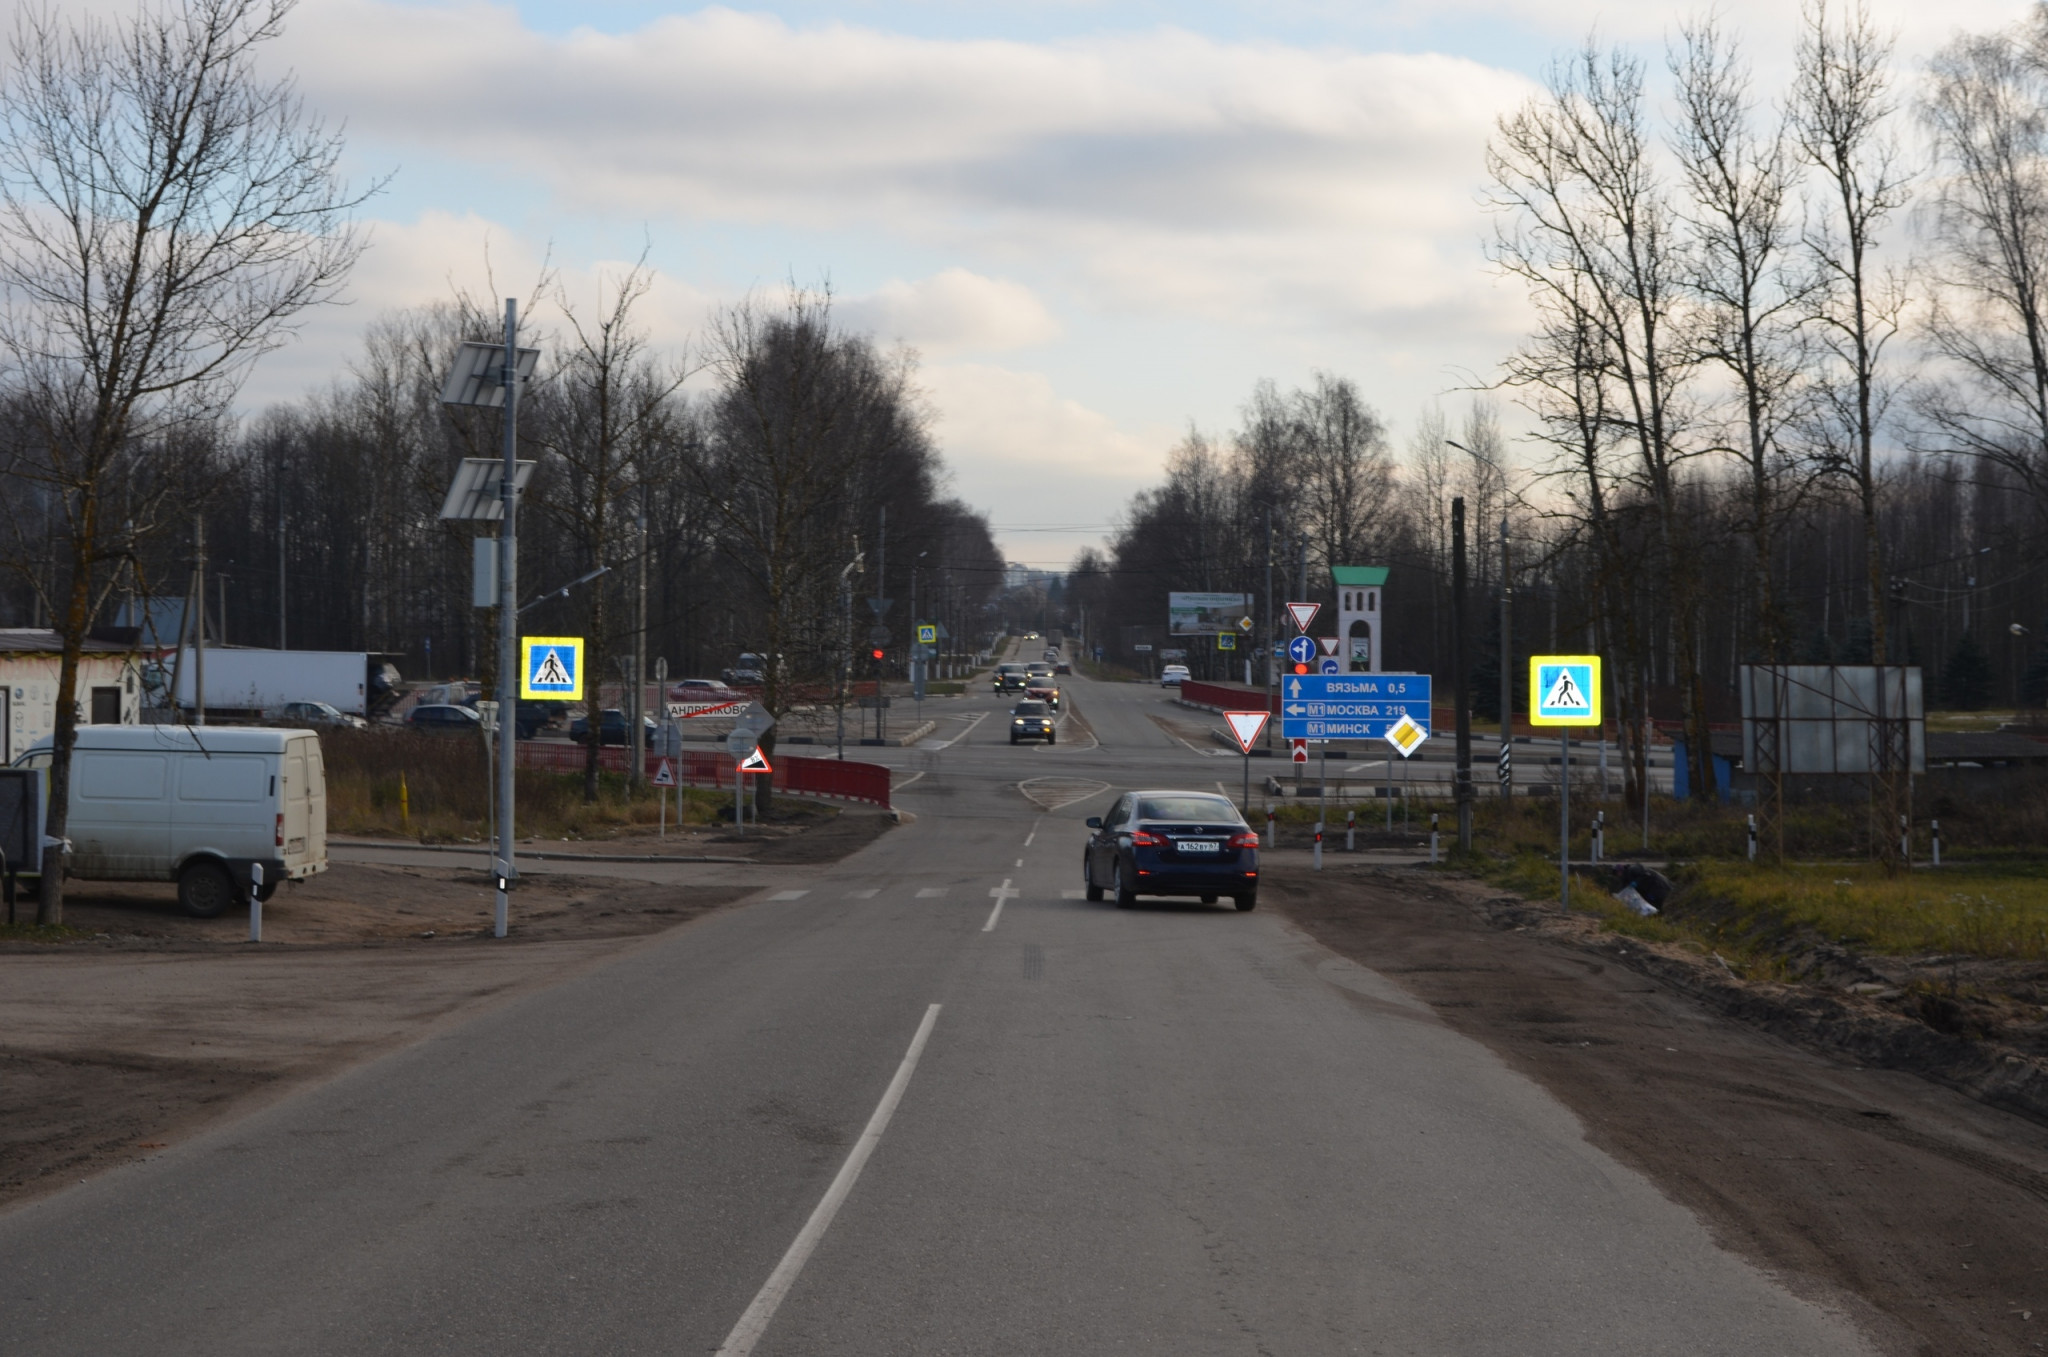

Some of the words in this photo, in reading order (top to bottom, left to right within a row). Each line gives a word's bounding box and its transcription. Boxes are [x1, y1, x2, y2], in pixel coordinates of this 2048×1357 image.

[1326, 682, 1378, 694] ВЯЗЬМА
[1387, 682, 1406, 695] 0,5
[1308, 705, 1325, 716] М1
[1326, 705, 1379, 716] МОСКВА
[1385, 705, 1407, 716] 219
[1326, 723, 1370, 734] МИНСК
